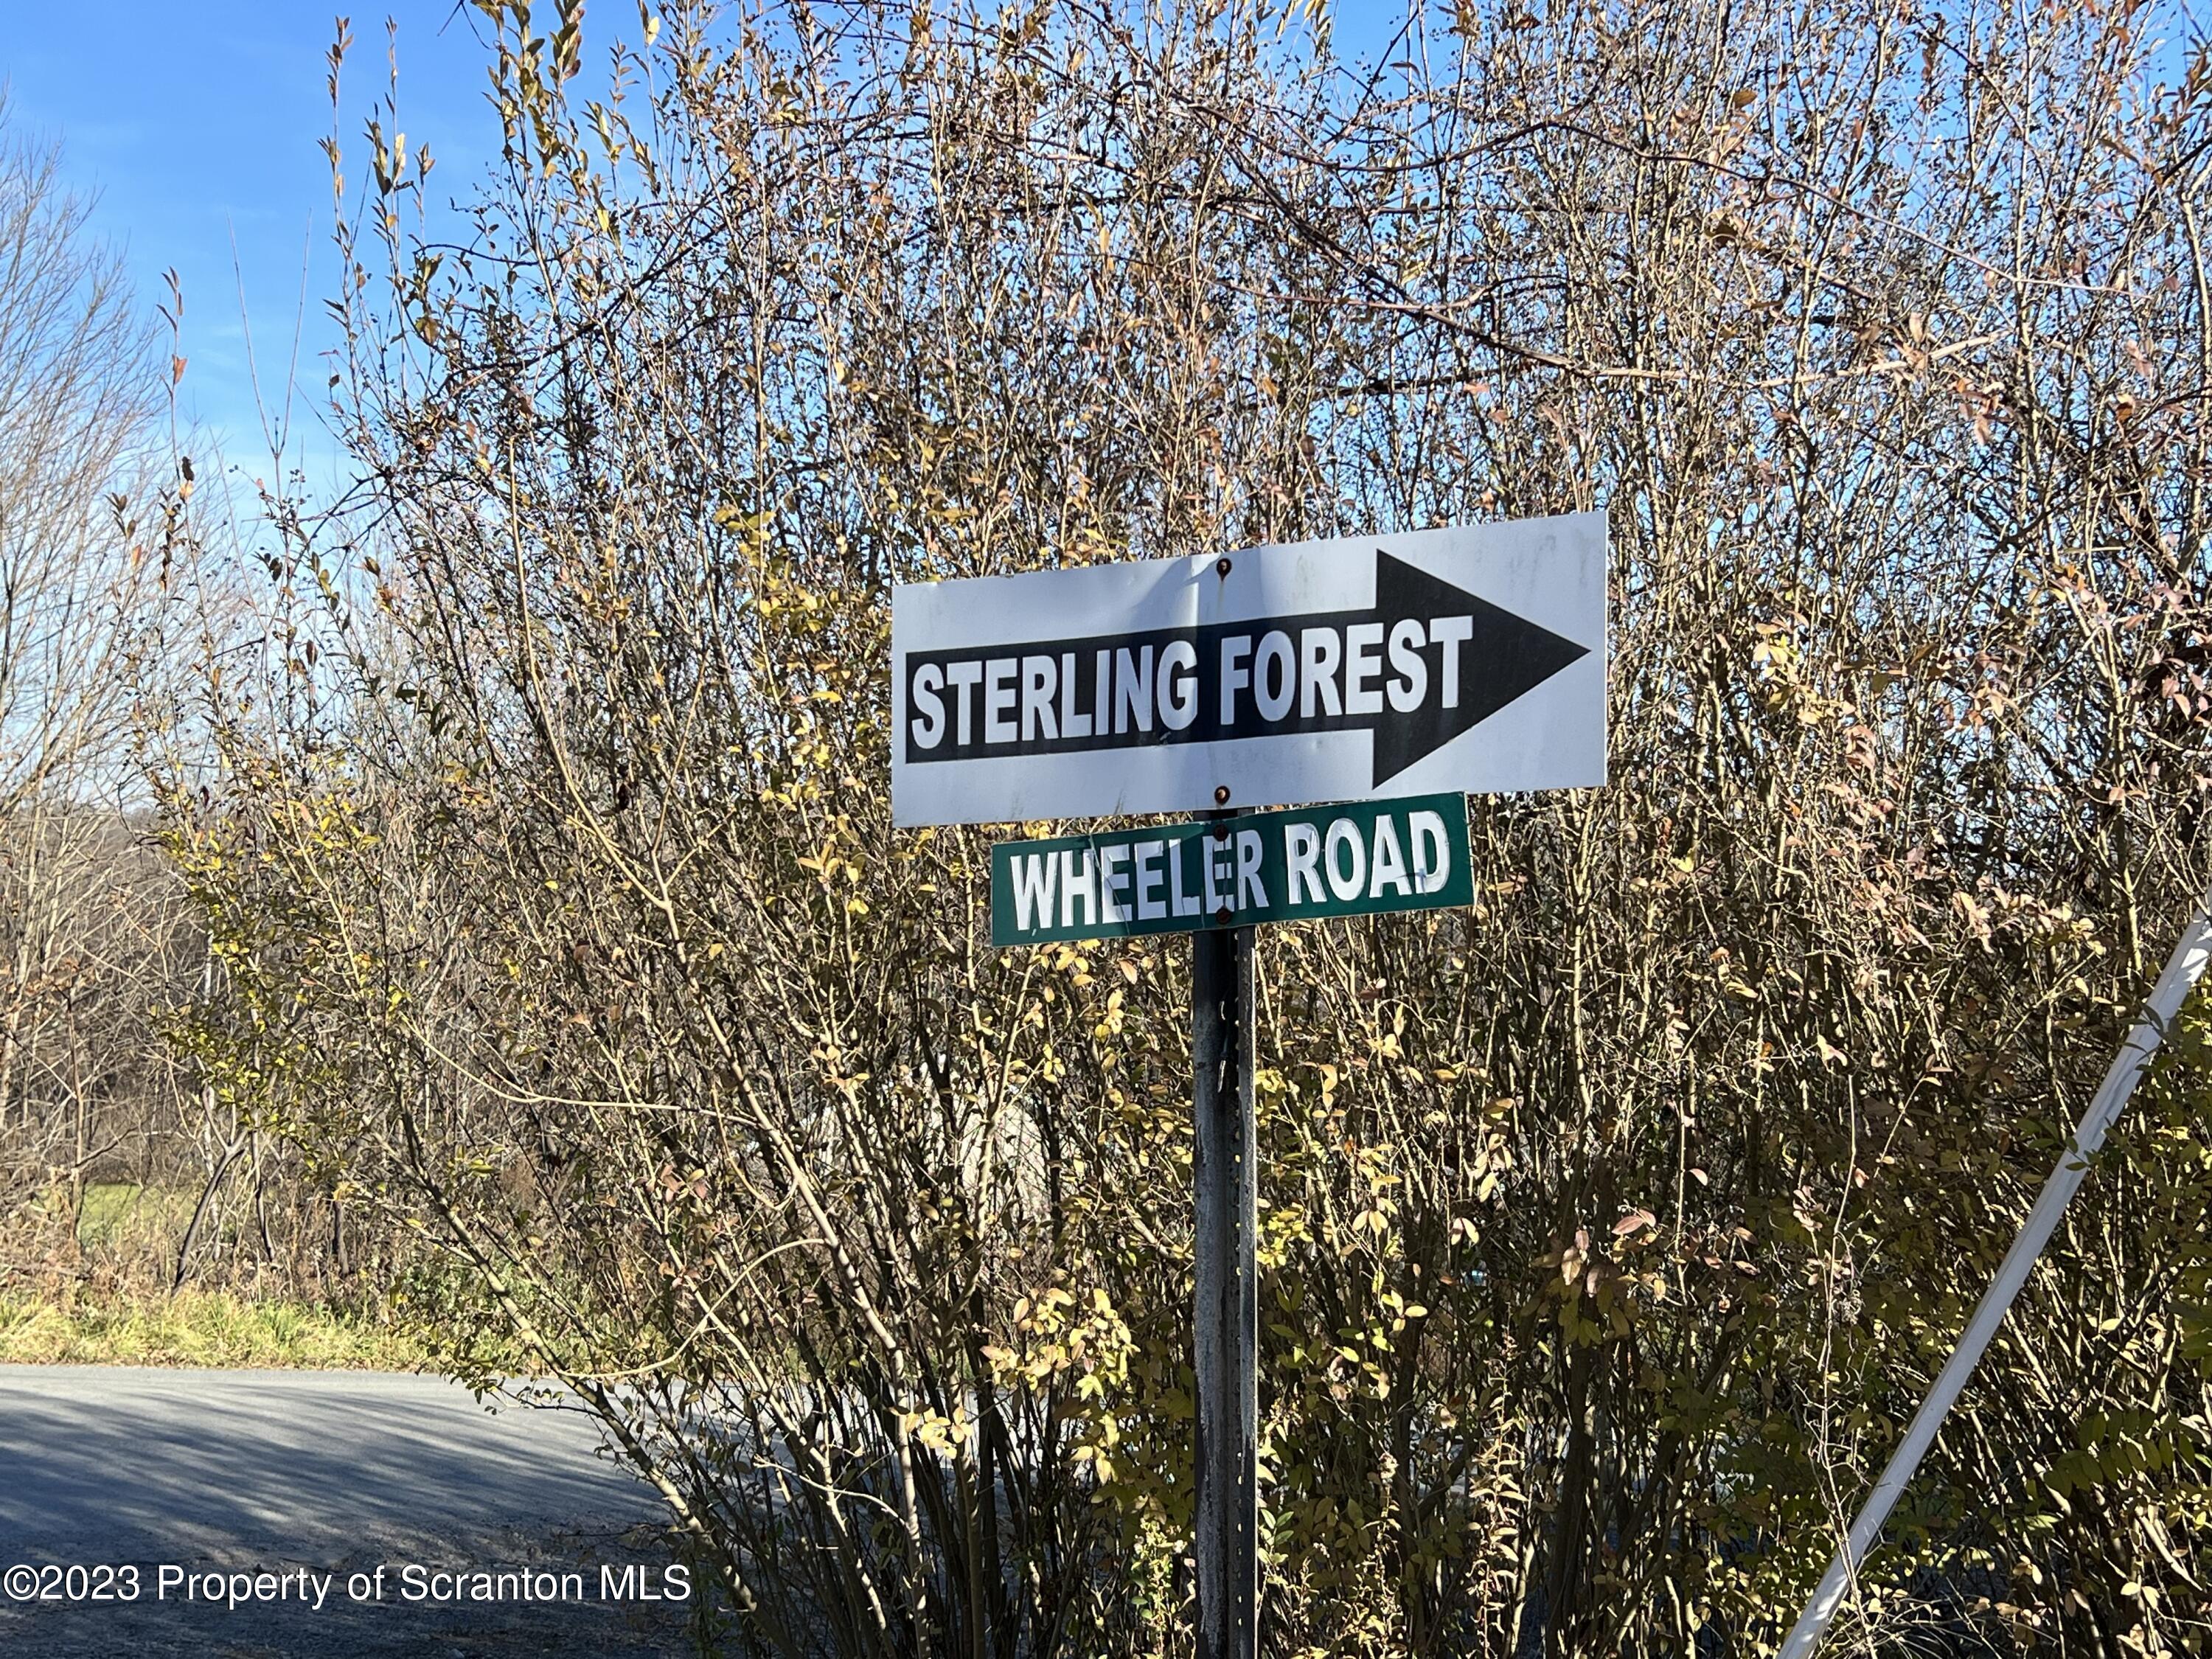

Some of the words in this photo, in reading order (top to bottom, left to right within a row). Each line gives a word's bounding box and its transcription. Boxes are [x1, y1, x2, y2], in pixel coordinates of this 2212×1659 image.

[911, 640, 1199, 750] STERLING
[1219, 615, 1474, 726] FOREST
[1009, 829, 1270, 931] WHEELER
[1285, 810, 1451, 905] ROAD
